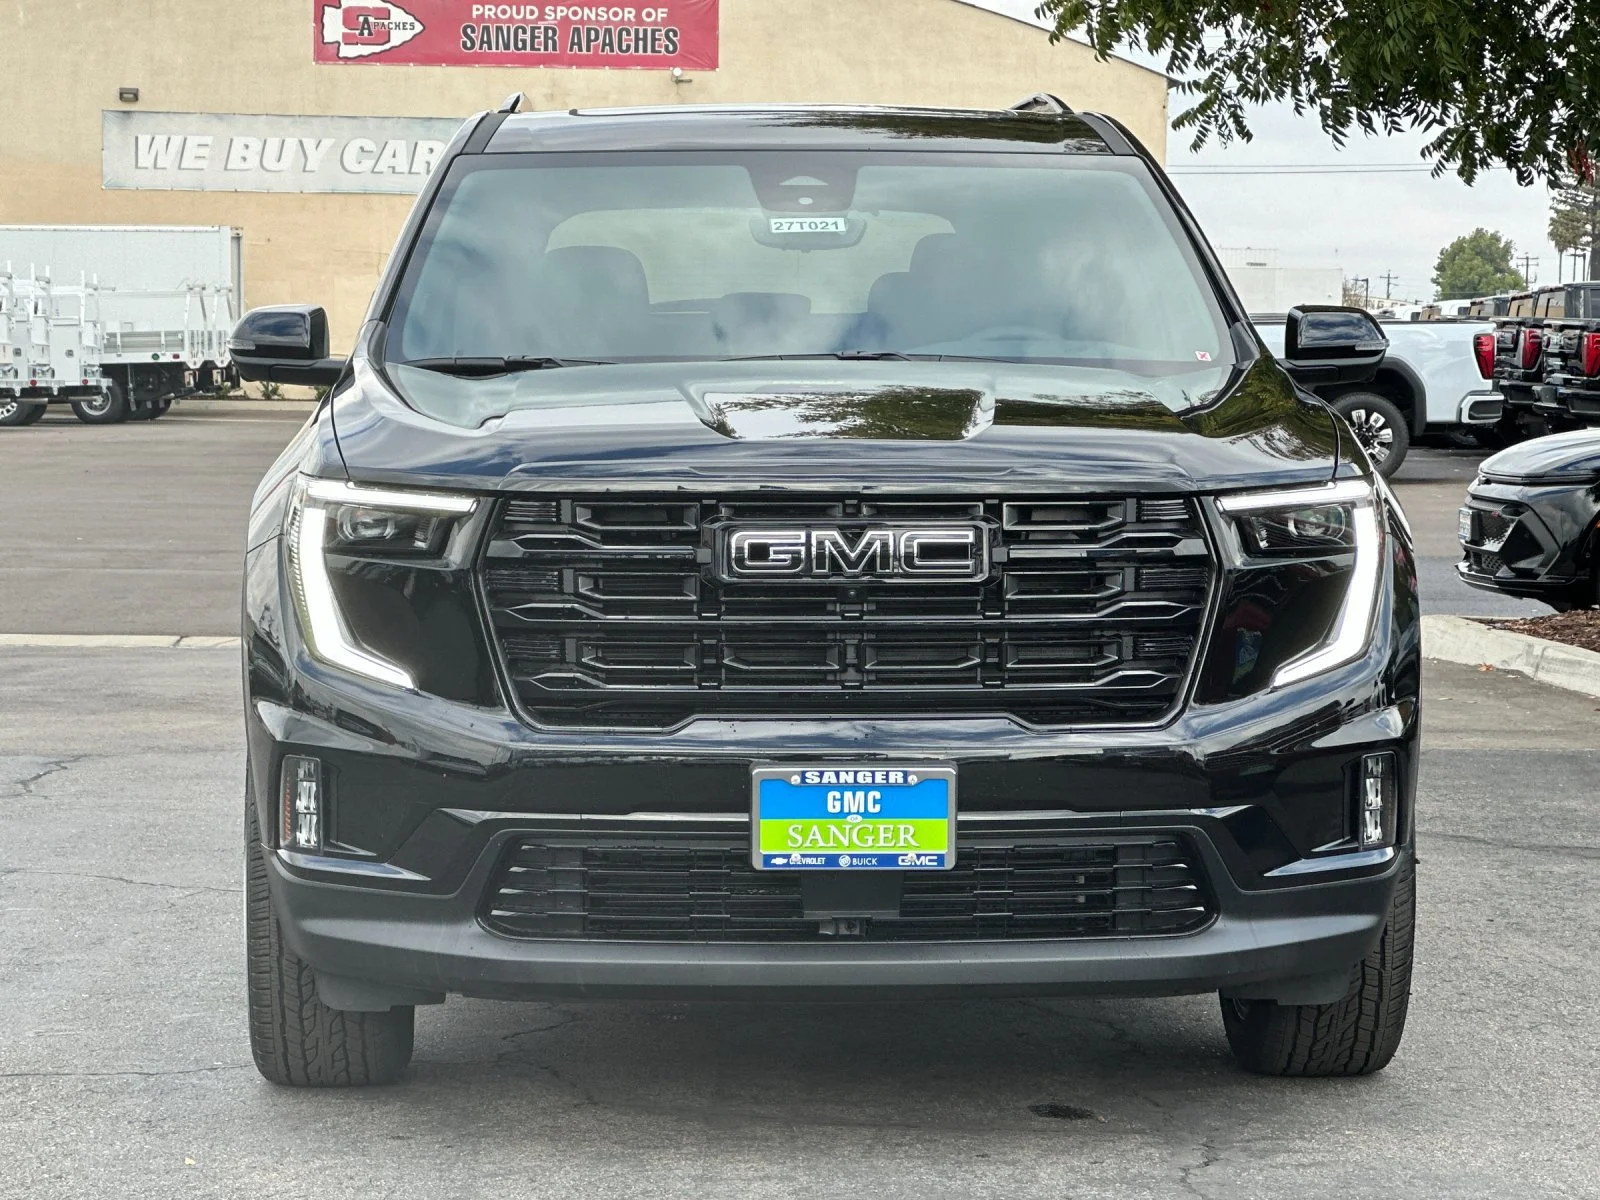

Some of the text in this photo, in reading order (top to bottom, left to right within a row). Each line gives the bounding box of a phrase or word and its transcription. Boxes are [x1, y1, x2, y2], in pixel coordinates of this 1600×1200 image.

[472, 5, 668, 23] PROUD SPONSOR OF
[358, 16, 415, 36] APACHES
[461, 23, 680, 55] SANGER APACHES
[135, 134, 213, 170] WE
[224, 137, 336, 173] BUY
[774, 221, 839, 231] 27T021
[731, 530, 975, 574] GMC
[805, 771, 904, 784] SANGER
[827, 791, 881, 813] GMC
[788, 824, 920, 848] SANGER
[852, 857, 878, 865] BUICK
[898, 855, 938, 866] GMC
